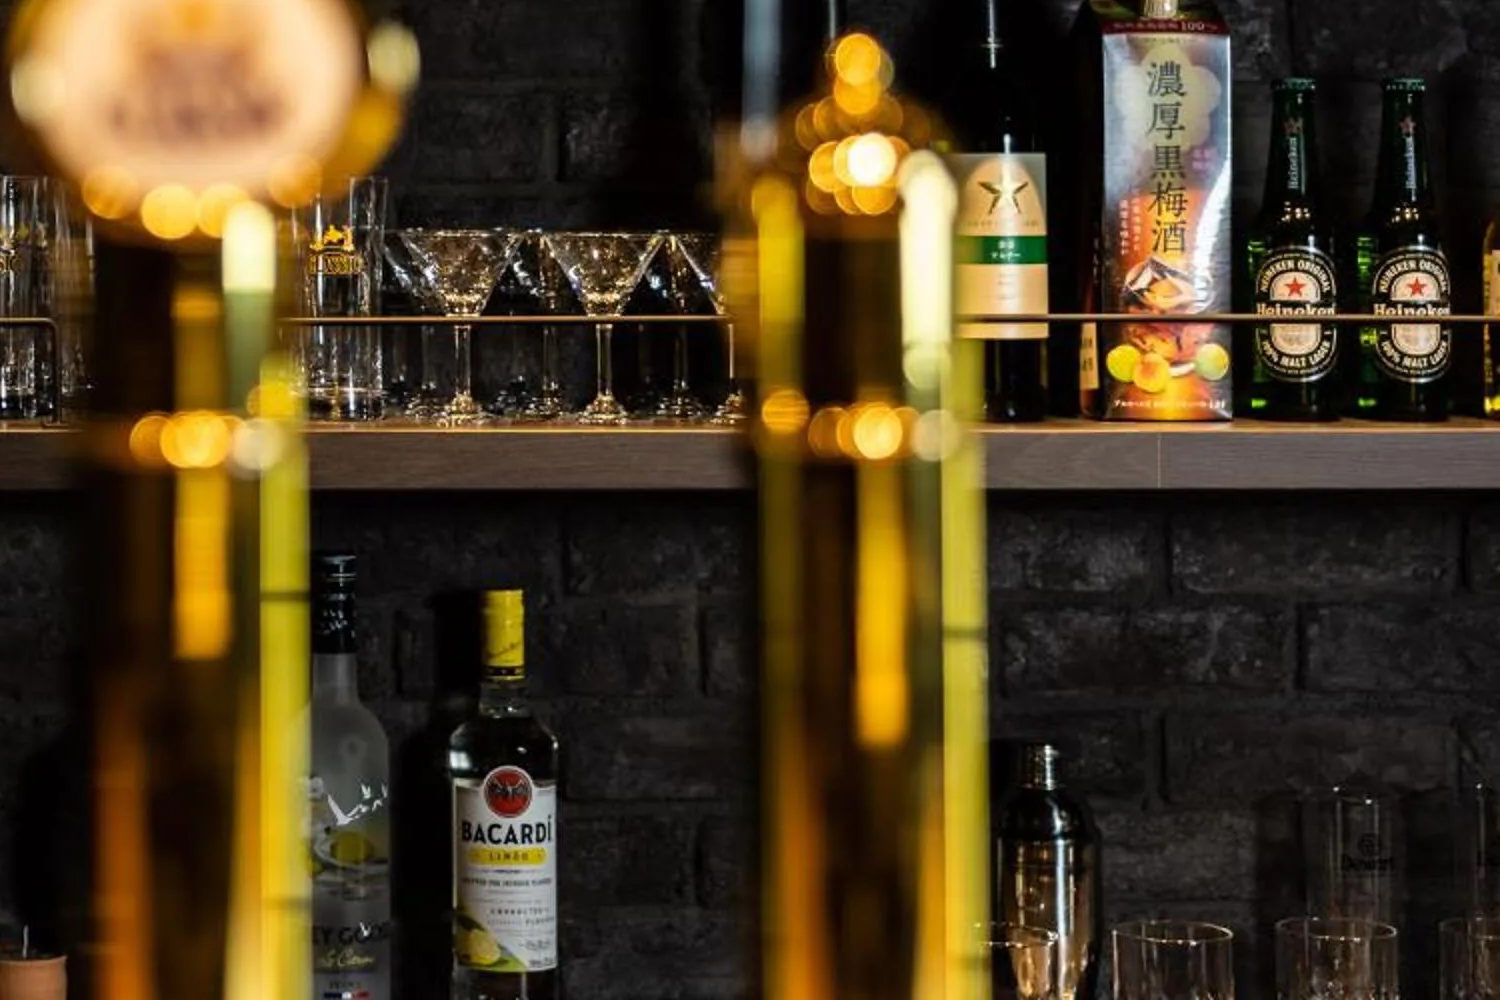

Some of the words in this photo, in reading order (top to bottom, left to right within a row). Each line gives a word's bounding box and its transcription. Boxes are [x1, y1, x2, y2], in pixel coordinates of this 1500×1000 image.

[1146, 61, 1189, 255] 濃厚黒梅酒
[461, 814, 552, 845] BACARDÍ
